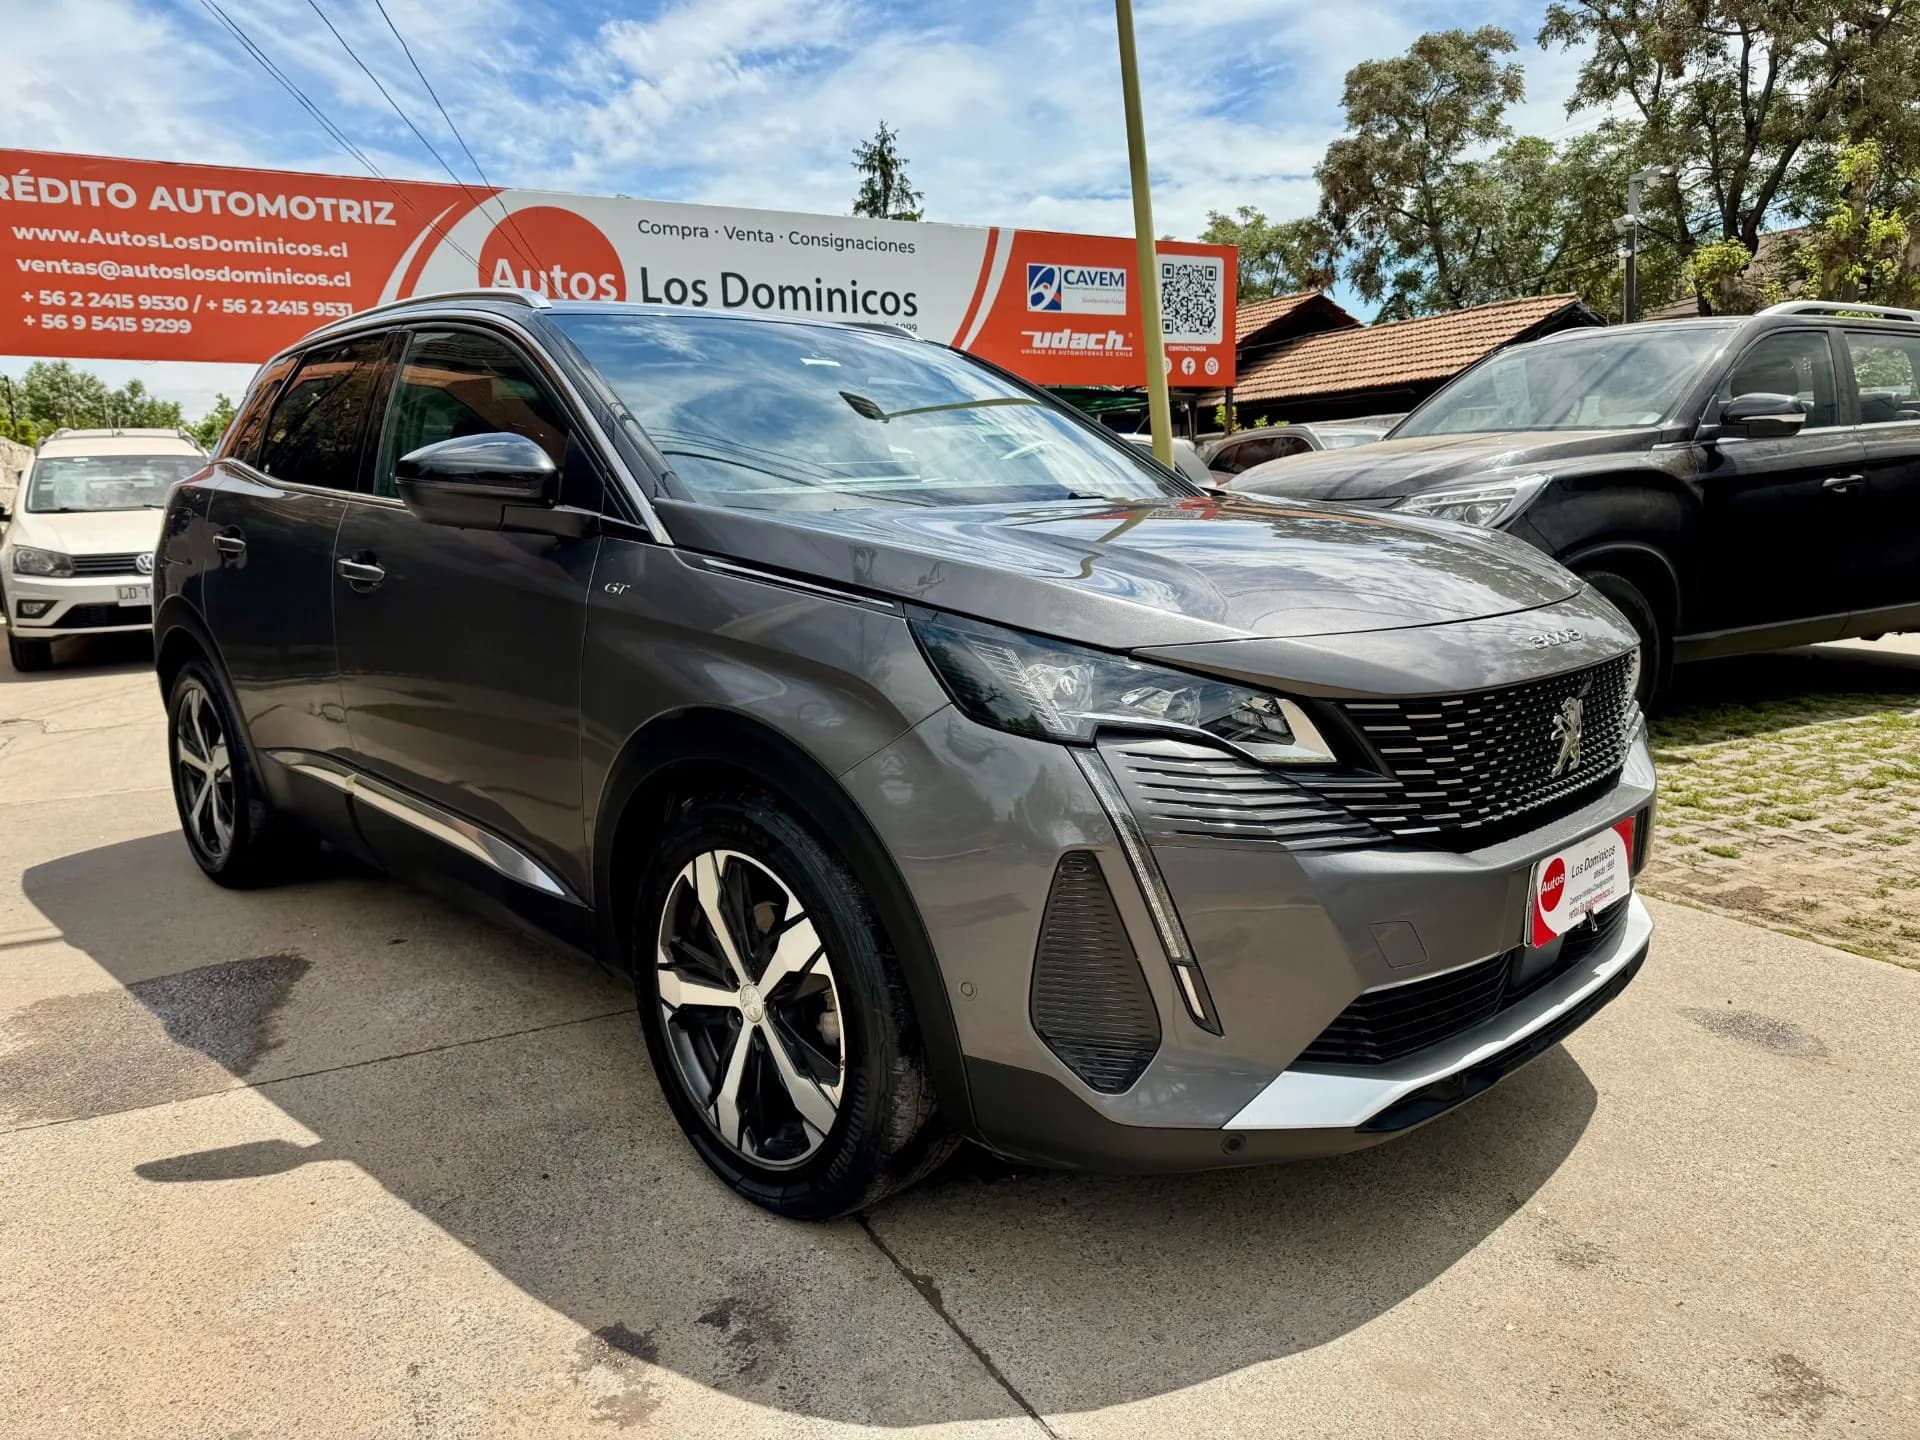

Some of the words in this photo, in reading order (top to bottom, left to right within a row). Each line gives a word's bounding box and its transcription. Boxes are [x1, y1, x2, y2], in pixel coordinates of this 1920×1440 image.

[148, 186, 397, 226] AUTOMOTRIZ
[12, 226, 348, 257] www.AutosLosDominicos.cl
[638, 219, 709, 240] Compra
[723, 225, 774, 243] Venta
[788, 231, 916, 254] Consignaciones
[16, 258, 351, 287] ventas@autoslosdominicos.cl
[490, 258, 618, 301] Autos
[640, 266, 709, 307] Los
[721, 271, 918, 317] Dominicos
[1063, 269, 1125, 287] CAVEM
[39, 290, 66, 307] 56
[70, 292, 84, 307] 2
[87, 293, 134, 309] 2415
[138, 296, 188, 312] 9530
[222, 298, 247, 313] 56
[251, 300, 263, 314] 2
[267, 300, 309, 316] 2415
[313, 302, 353, 318] 9531
[41, 314, 68, 329] 56
[72, 315, 86, 330] 9
[91, 316, 137, 332] 5415
[141, 318, 192, 334] 9299
[604, 582, 631, 595] GT
[1540, 873, 1565, 896] Autos
[1571, 863, 1584, 879] Los
[1584, 844, 1616, 871] Dominicos
